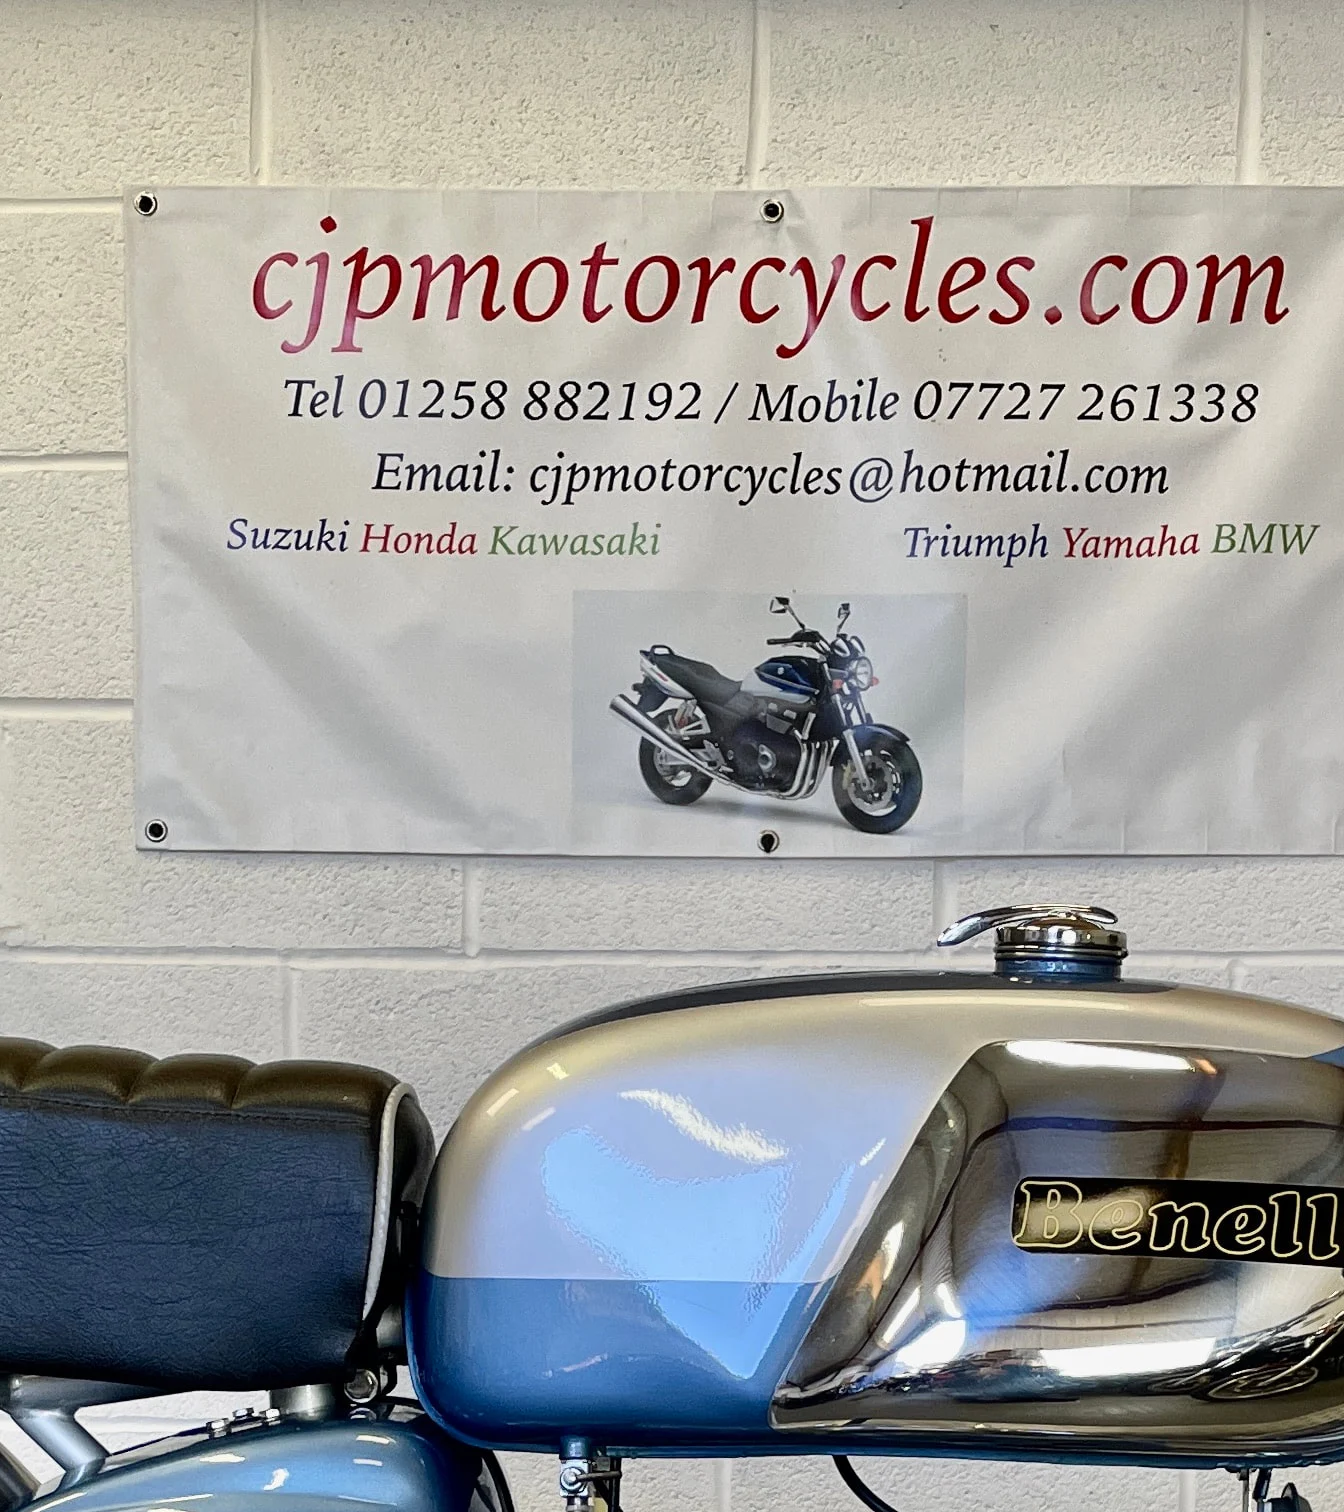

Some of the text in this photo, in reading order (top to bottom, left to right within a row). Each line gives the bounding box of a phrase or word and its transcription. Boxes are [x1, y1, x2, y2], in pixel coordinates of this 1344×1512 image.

[253, 217, 1289, 359] cjpmotorcycles.com
[283, 375, 1259, 425] Tel 01258 882192 / Mobile 07727 261338
[371, 448, 1169, 507] Email: cjpmotorcycles@hotmail.com
[226, 517, 662, 557] Suzuki Honda Kawasaki
[904, 522, 1321, 566] Triumph Yamaha BMW
